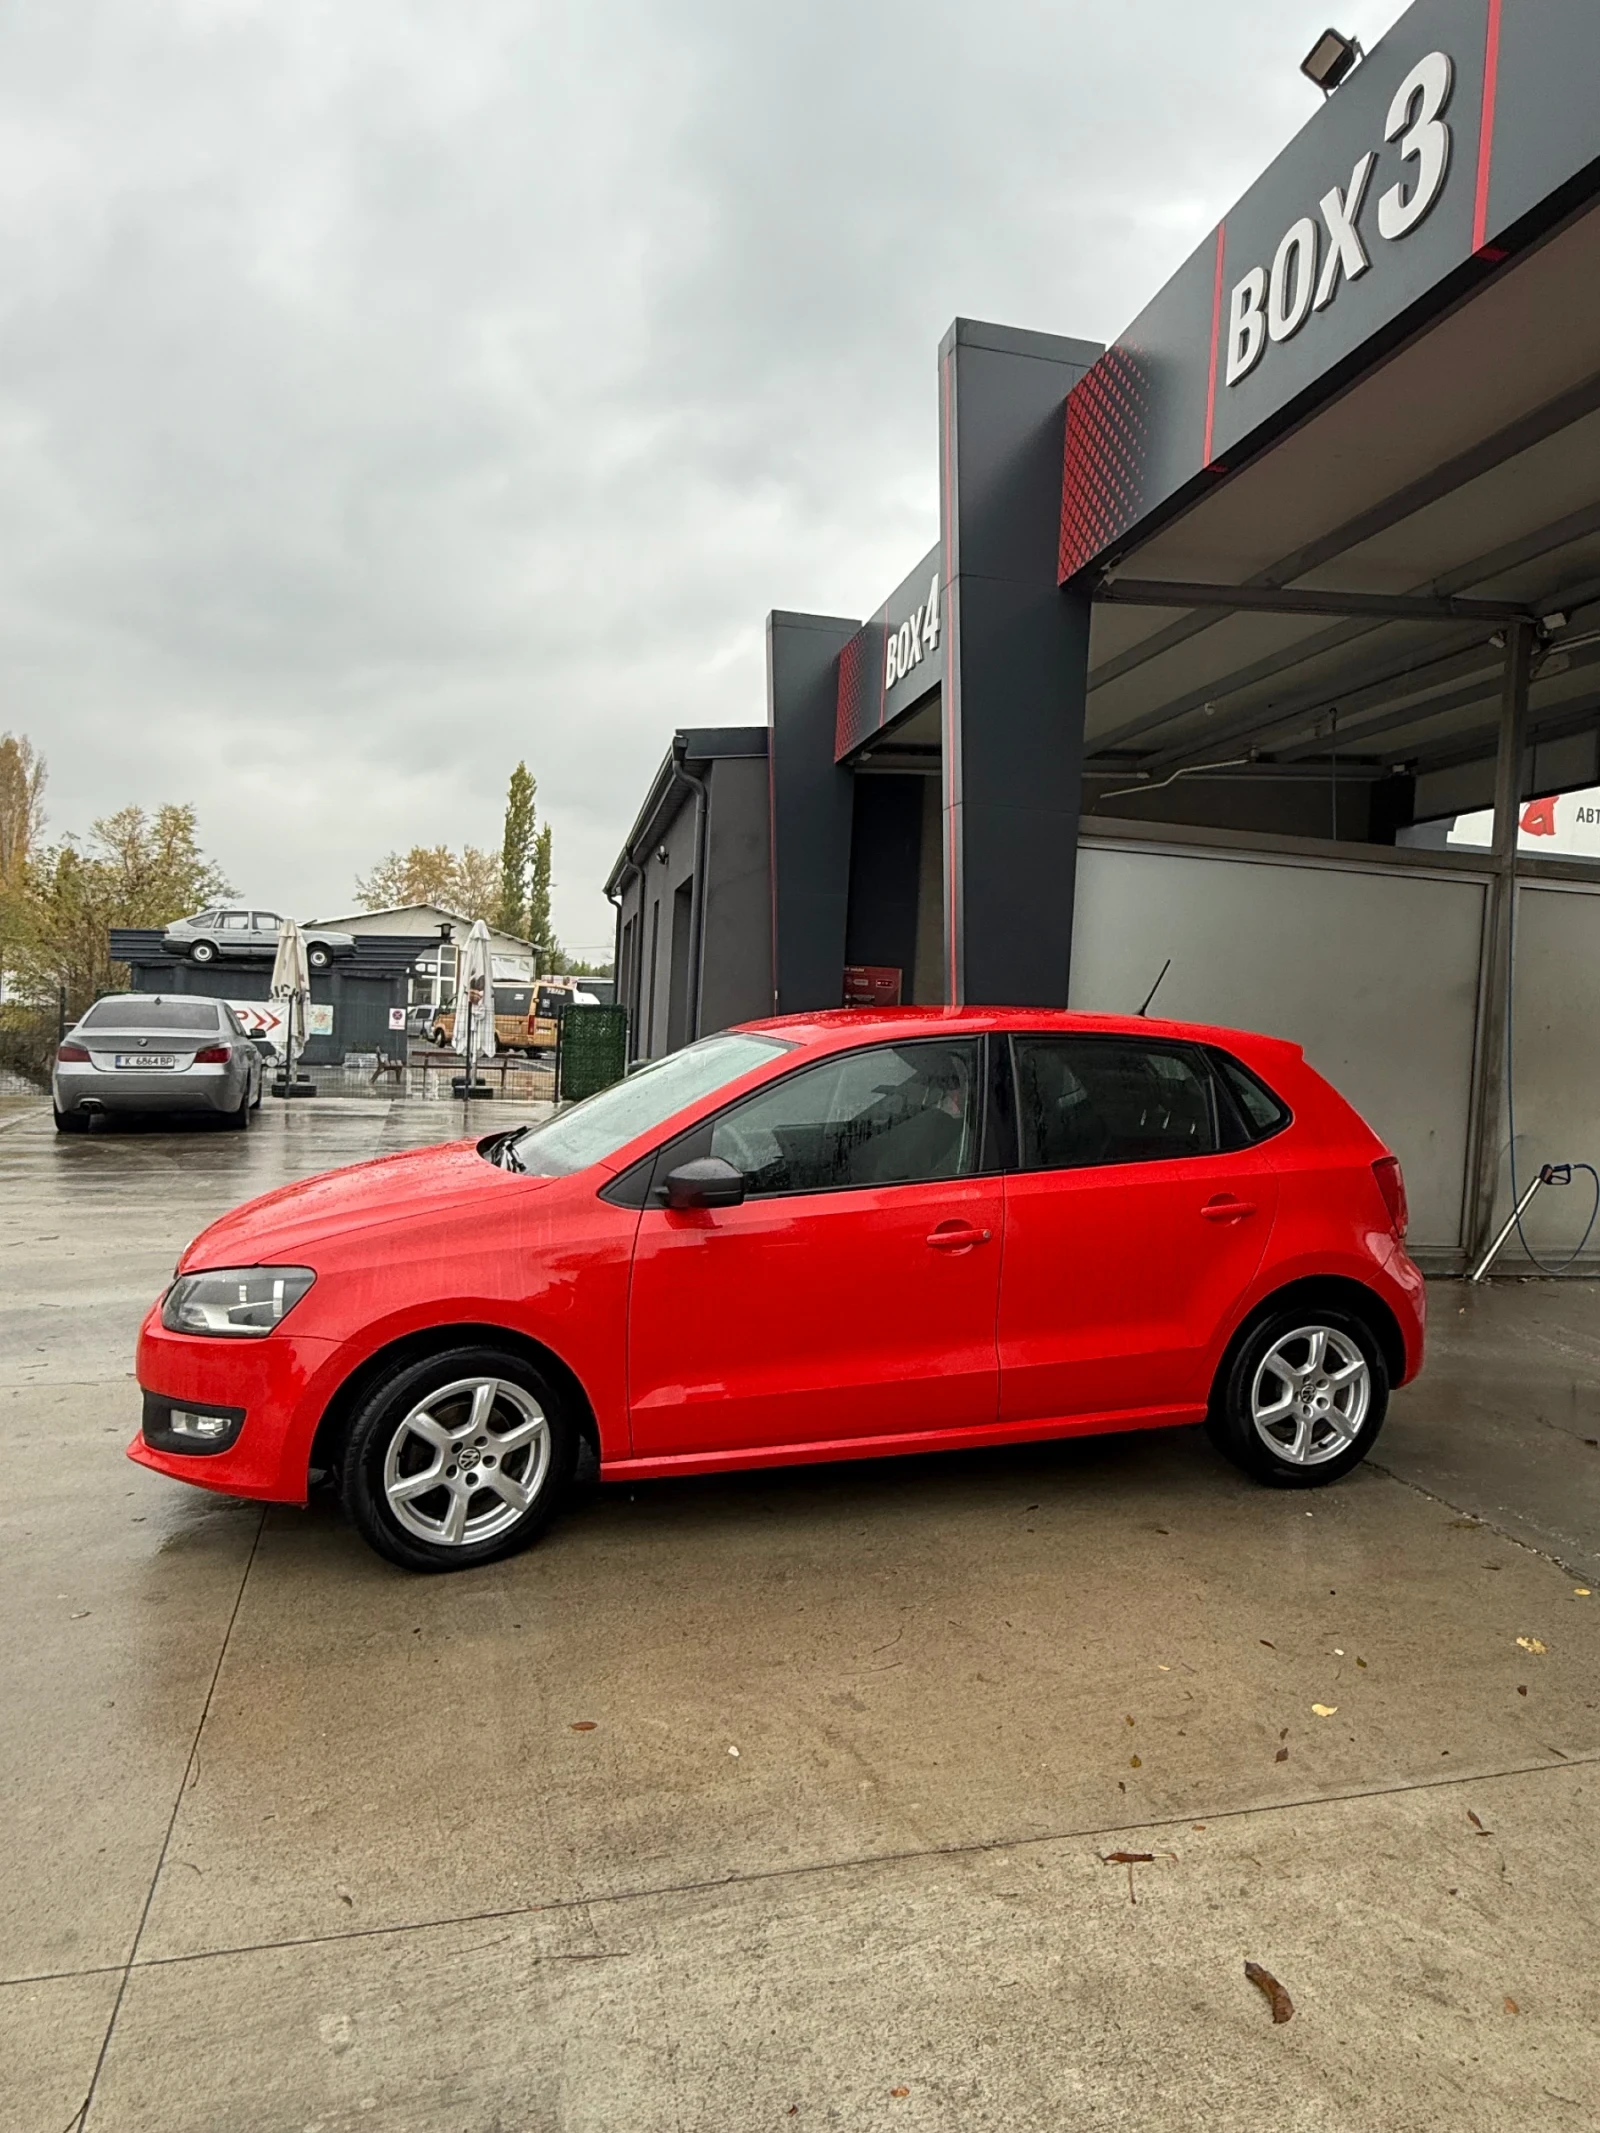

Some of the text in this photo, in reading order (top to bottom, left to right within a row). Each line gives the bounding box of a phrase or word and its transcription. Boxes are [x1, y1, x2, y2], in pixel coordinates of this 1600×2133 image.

[1226, 51, 1453, 388] BOX 3
[885, 572, 941, 691] BOX 4
